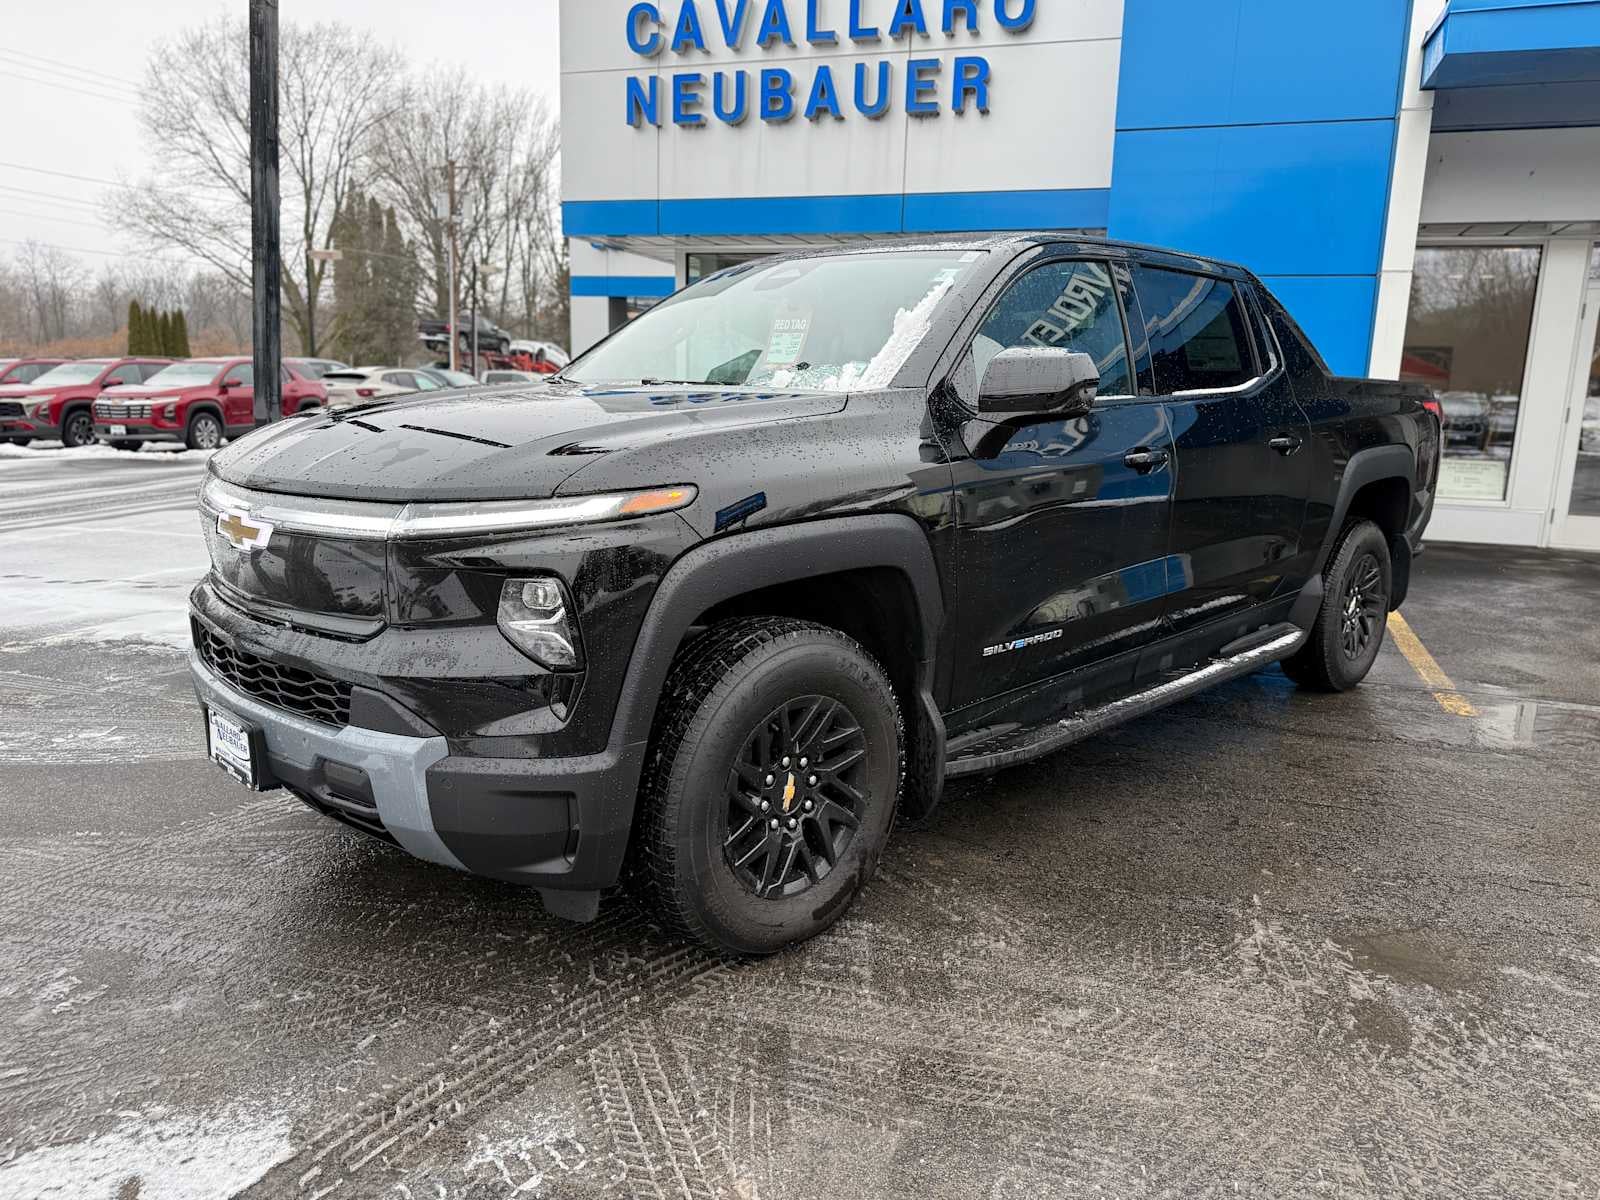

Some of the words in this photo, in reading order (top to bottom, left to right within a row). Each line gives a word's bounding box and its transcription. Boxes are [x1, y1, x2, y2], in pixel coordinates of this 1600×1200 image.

[626, 0, 1037, 57] CAVALLARO
[626, 55, 991, 128] NEUBAUER
[982, 628, 1063, 657] SILVERADO
